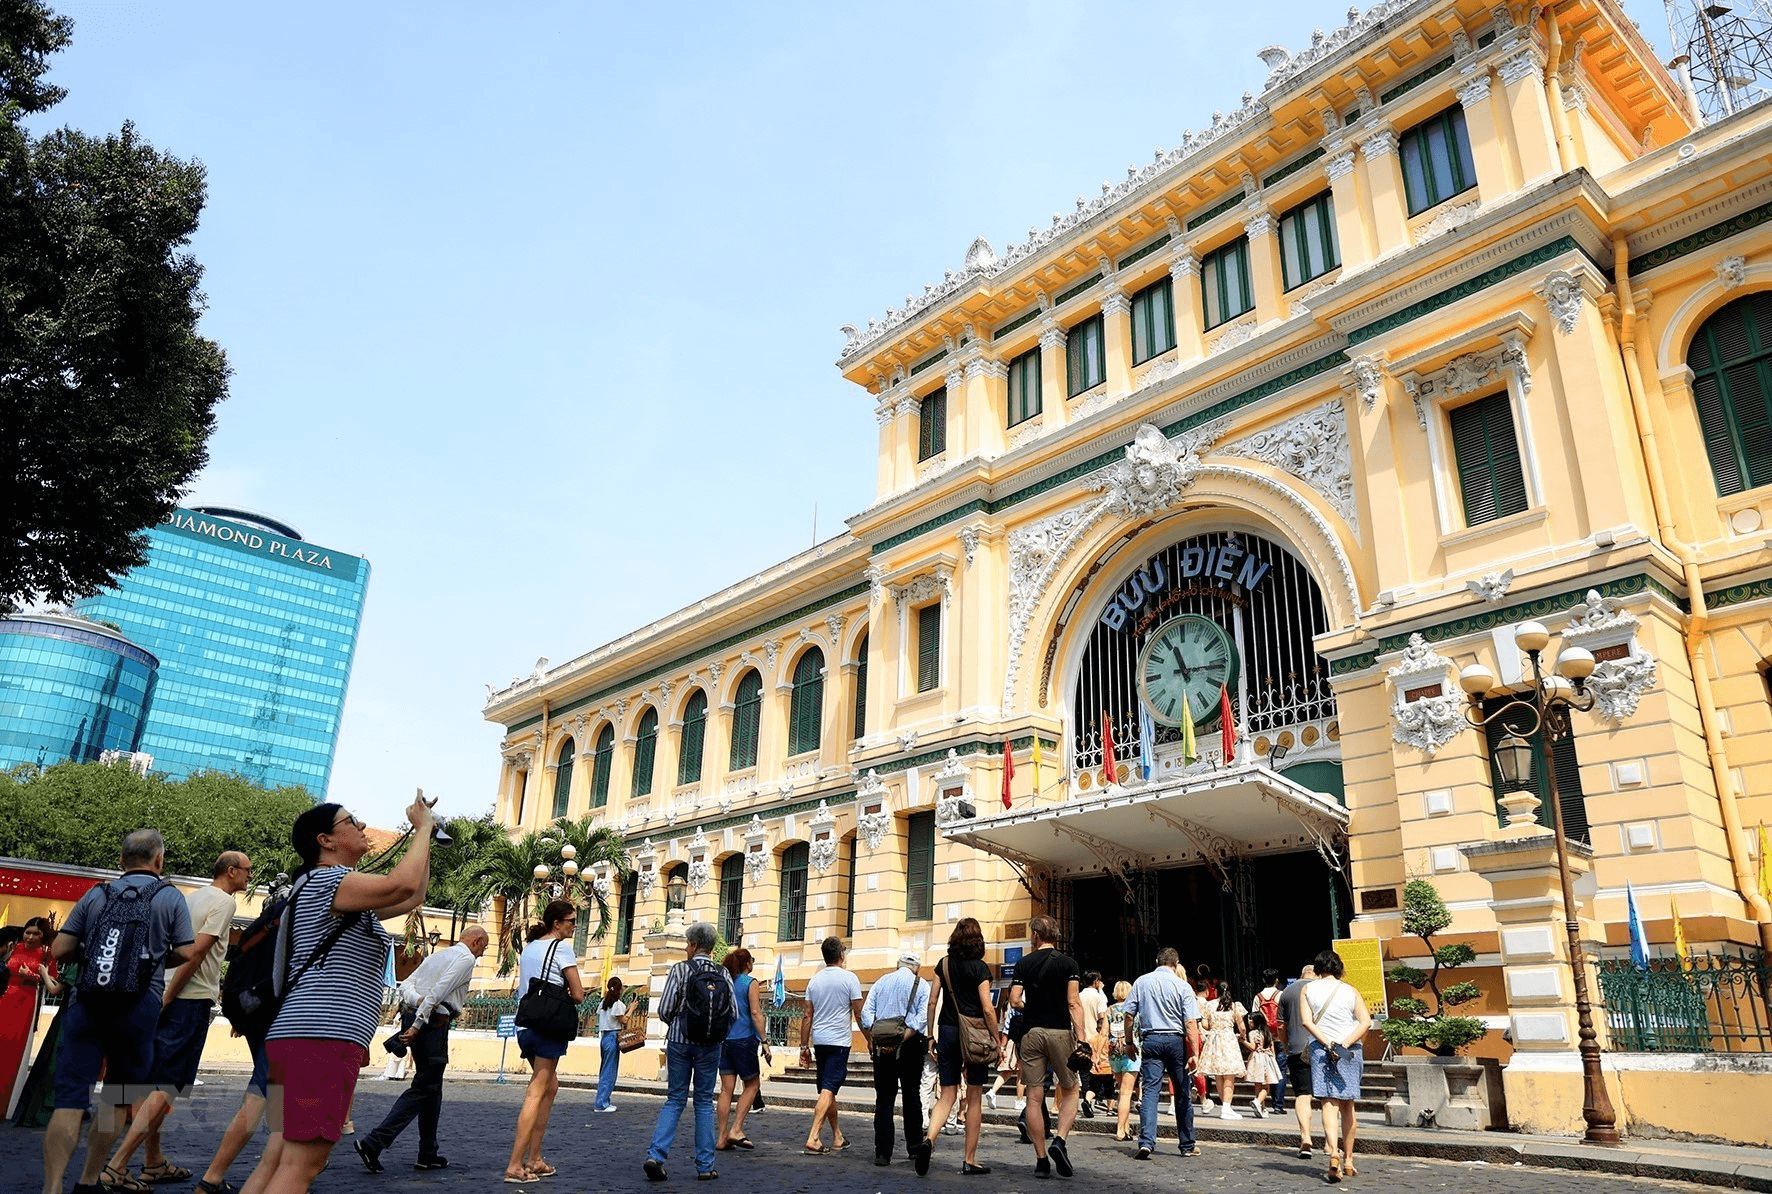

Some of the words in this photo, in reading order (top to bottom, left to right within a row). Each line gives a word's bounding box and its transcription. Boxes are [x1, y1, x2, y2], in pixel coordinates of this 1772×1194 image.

[269, 540, 332, 570] PLAZA
[1180, 537, 1270, 591] ĐIỆN
[97, 927, 120, 986] adidas
